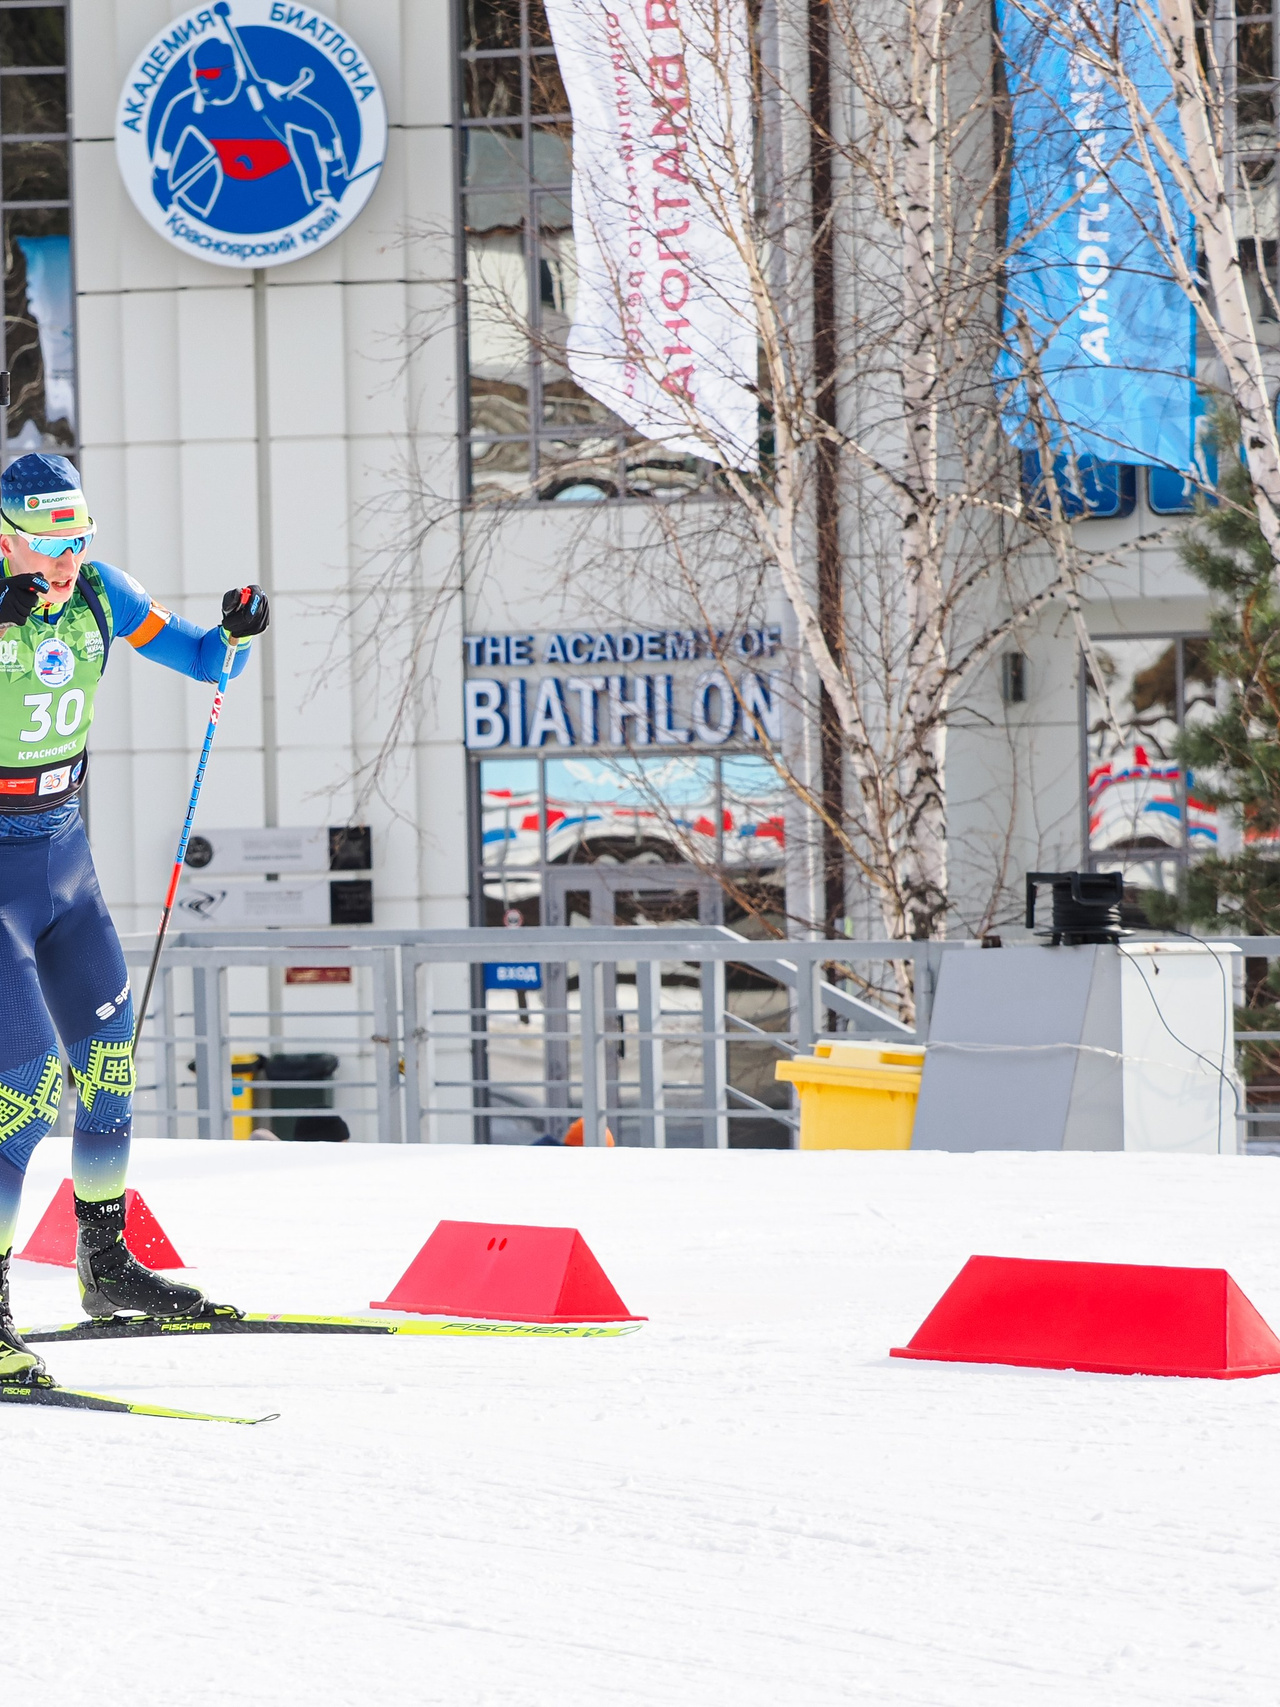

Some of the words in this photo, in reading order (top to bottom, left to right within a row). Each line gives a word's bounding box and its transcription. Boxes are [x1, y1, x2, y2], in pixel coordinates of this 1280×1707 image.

[122, 9, 217, 132] АКАДЕМИЯ
[268, 3, 375, 102] БИАТЛОНА
[164, 211, 297, 261] Красноярский
[299, 207, 342, 245] край
[464, 635, 534, 666] THE
[543, 629, 722, 665] ACADEMY
[737, 627, 783, 657] OF
[19, 688, 85, 742] 30
[464, 669, 784, 749] BIATHLON
[18, 739, 77, 761] КРАСНОЯРСК
[496, 966, 538, 983] ВХОД
[100, 1203, 120, 1214] 180
[161, 1322, 211, 1332] FISCHER
[441, 1323, 579, 1335] FISCHER
[3, 1388, 32, 1396] FISCHER
